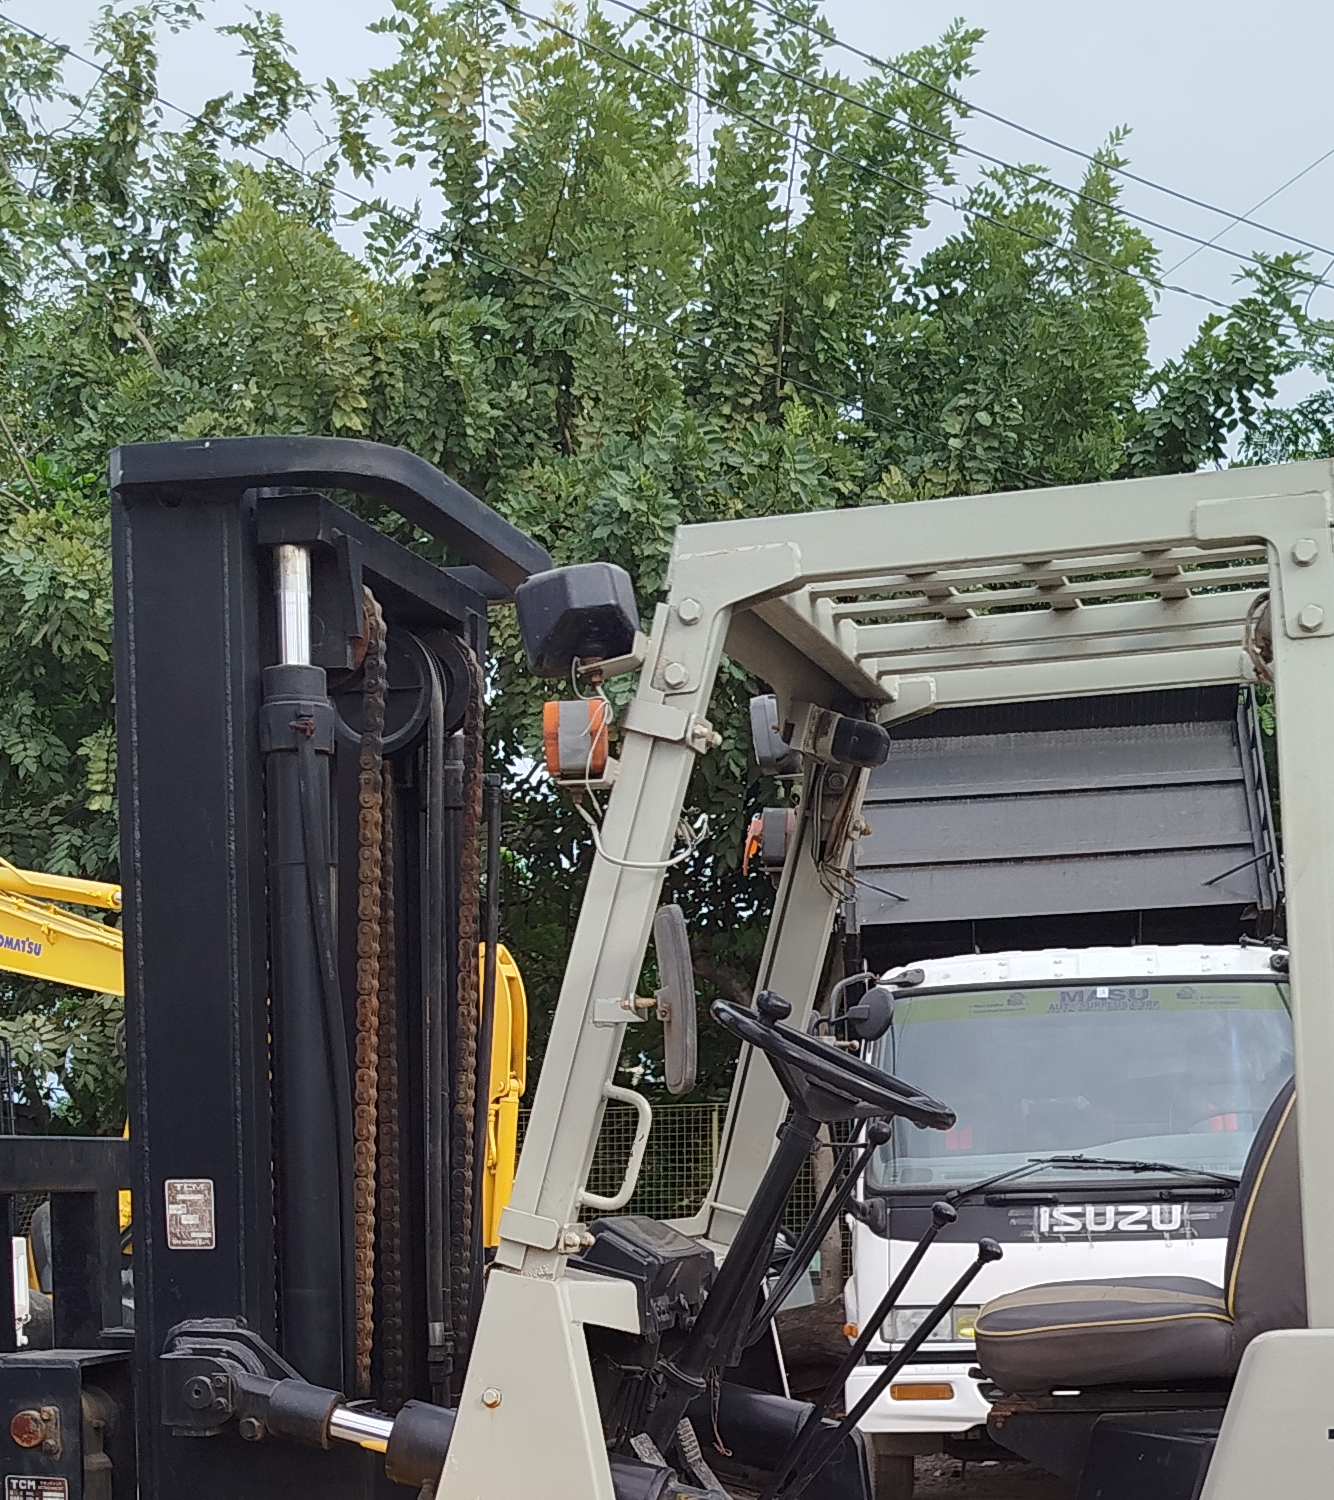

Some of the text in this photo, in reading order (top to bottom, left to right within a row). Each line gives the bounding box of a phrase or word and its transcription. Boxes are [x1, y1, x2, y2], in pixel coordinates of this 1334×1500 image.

[1060, 988, 1150, 1004] MASU
[1040, 1205, 1181, 1232] ISUZU
[10, 1479, 36, 1491] TCM
